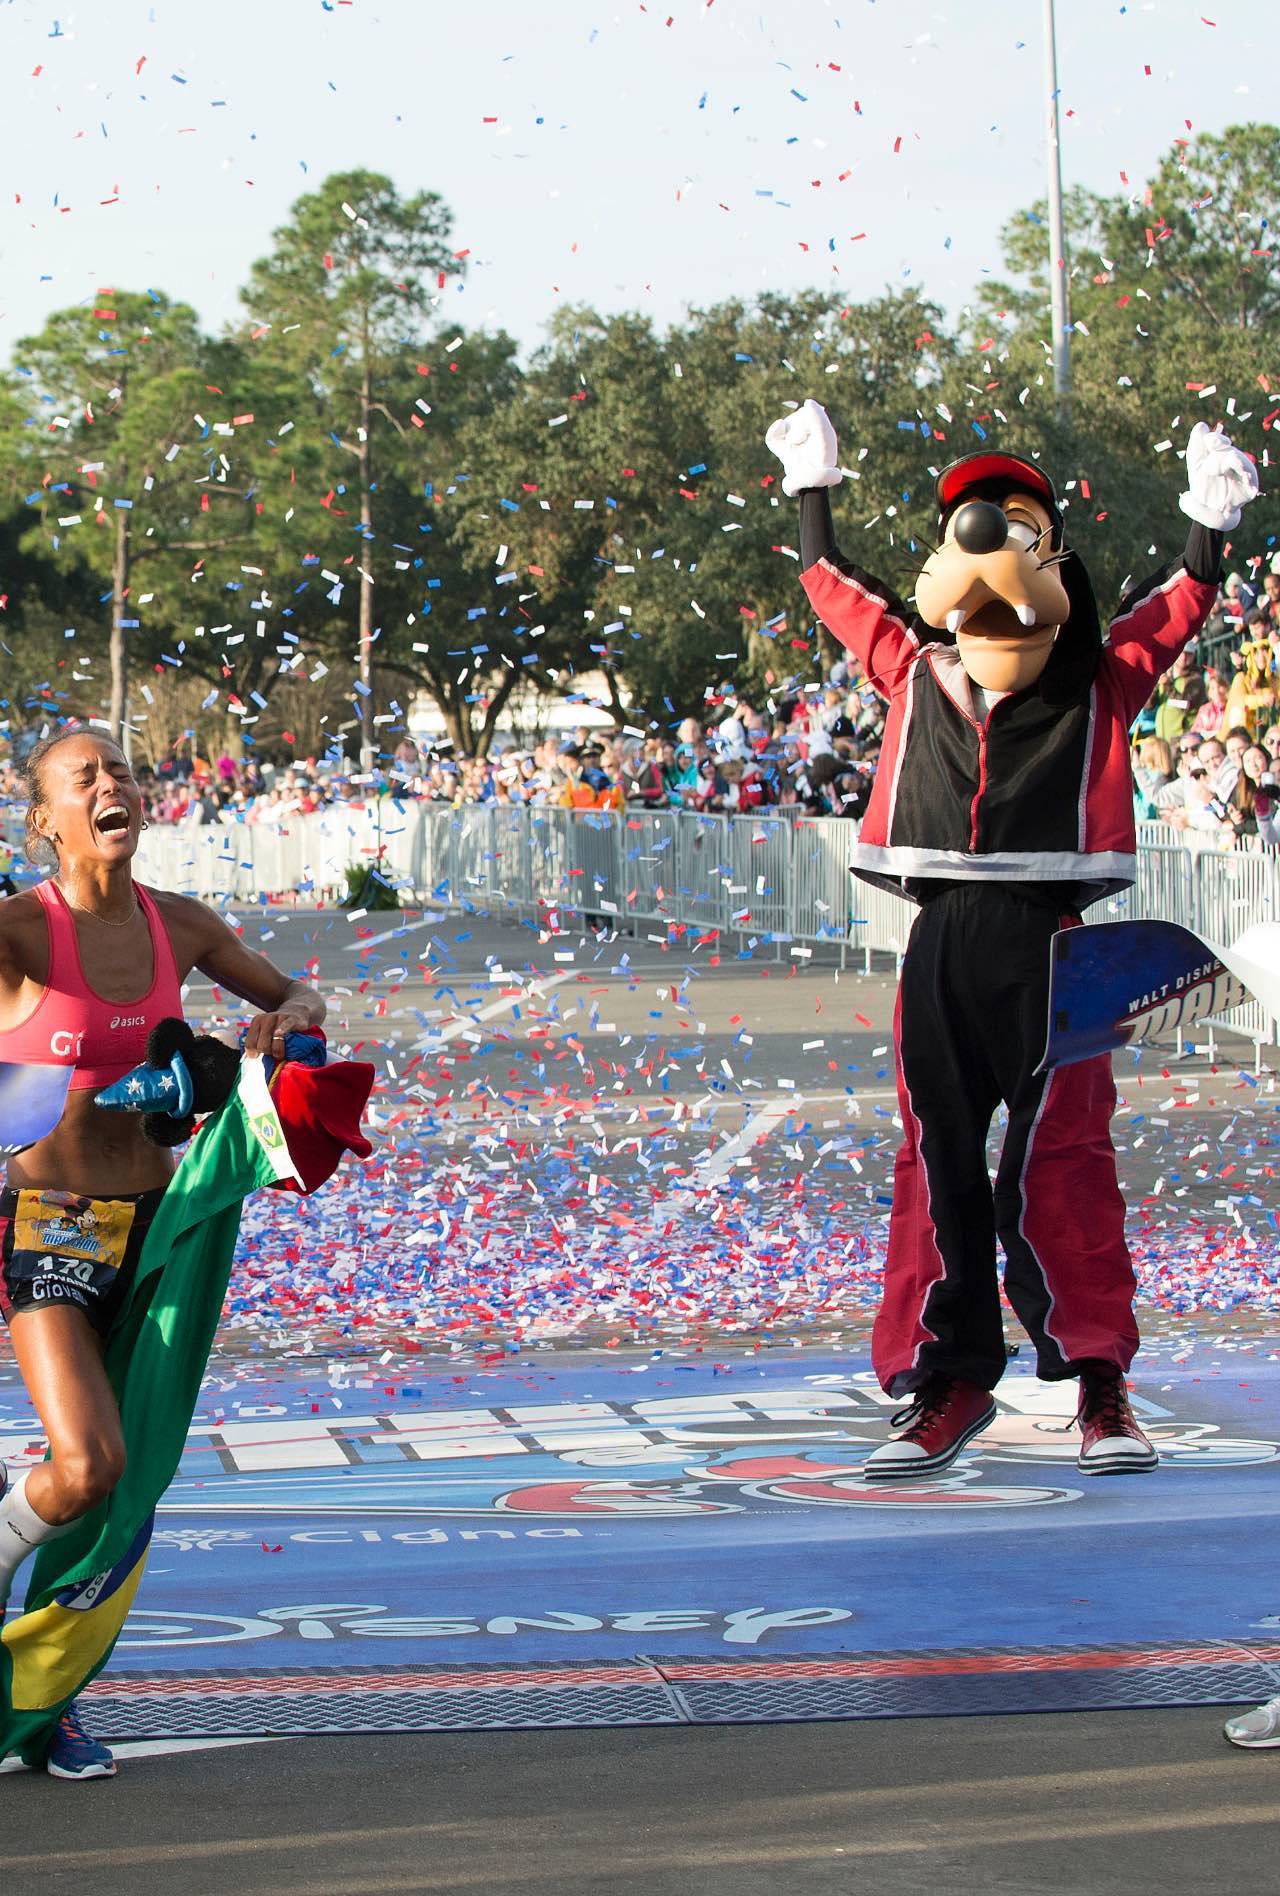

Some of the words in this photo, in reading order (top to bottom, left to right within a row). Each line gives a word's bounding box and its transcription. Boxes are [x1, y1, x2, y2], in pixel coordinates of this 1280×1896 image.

[1129, 984, 1169, 1014] WALT
[1176, 959, 1221, 990] DISNE
[37, 1255, 94, 1283] 170
[289, 1527, 584, 1545] Cigna
